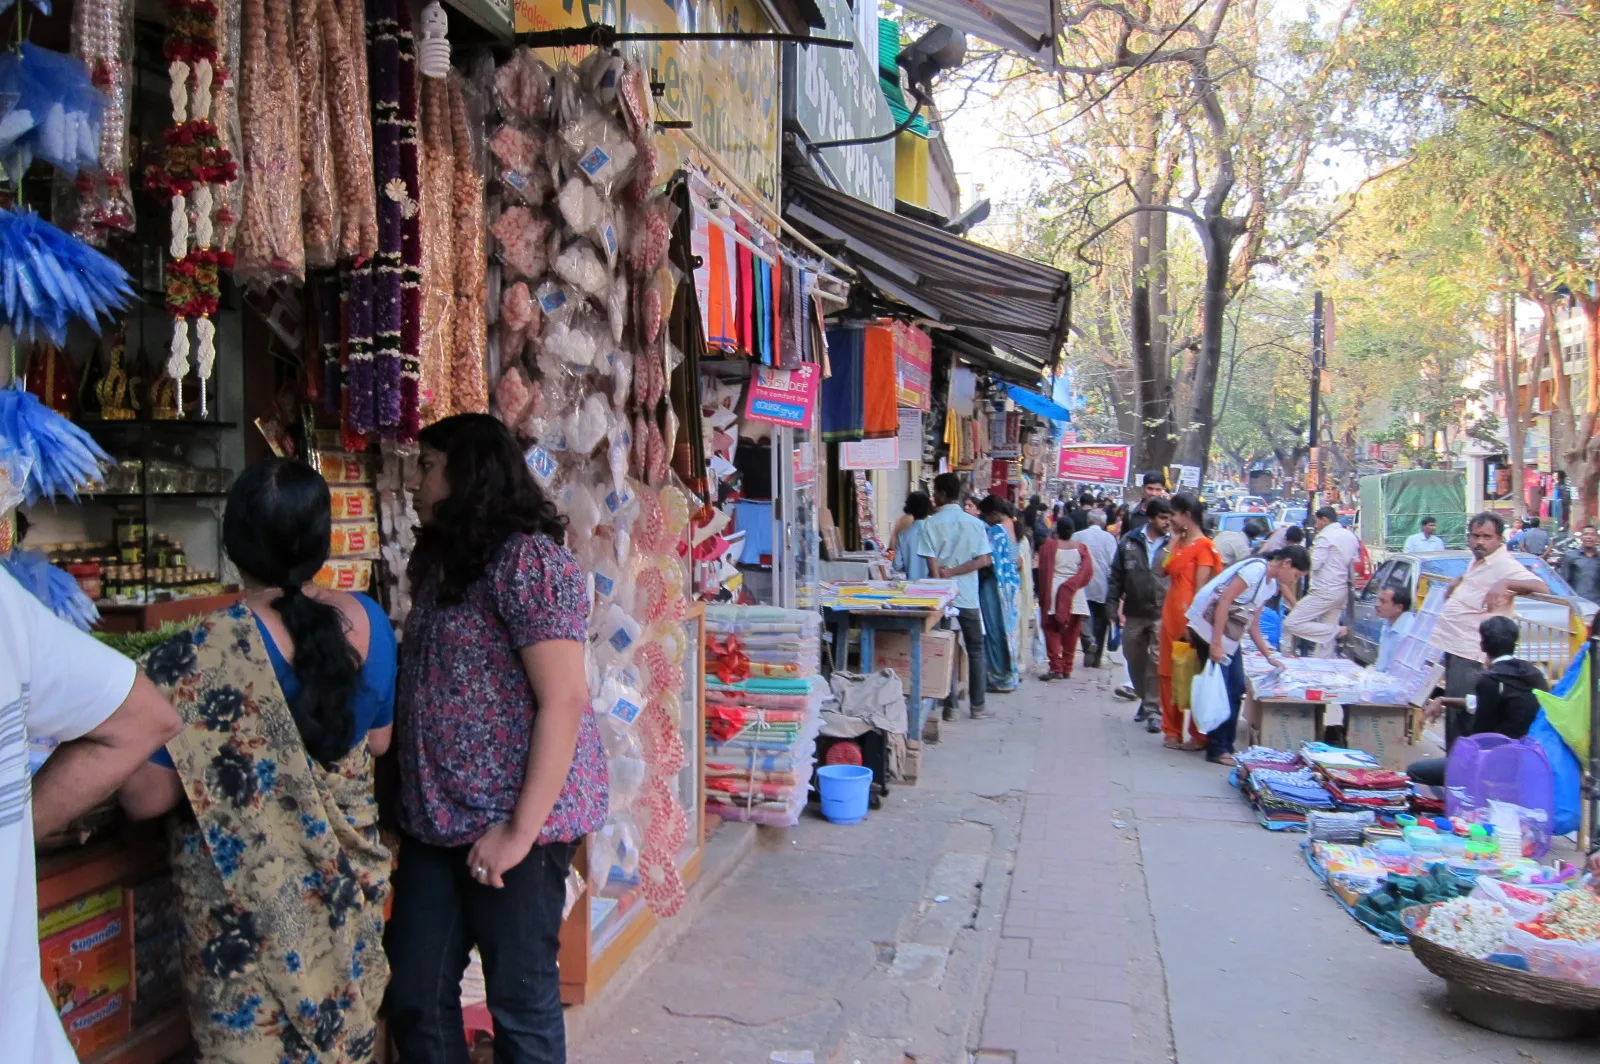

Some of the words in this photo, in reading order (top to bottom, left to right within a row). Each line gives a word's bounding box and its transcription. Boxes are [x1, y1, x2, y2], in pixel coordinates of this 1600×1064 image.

[789, 381, 808, 393] DEE
[769, 392, 796, 401] comfort
[69, 919, 121, 954] Sugandhi
